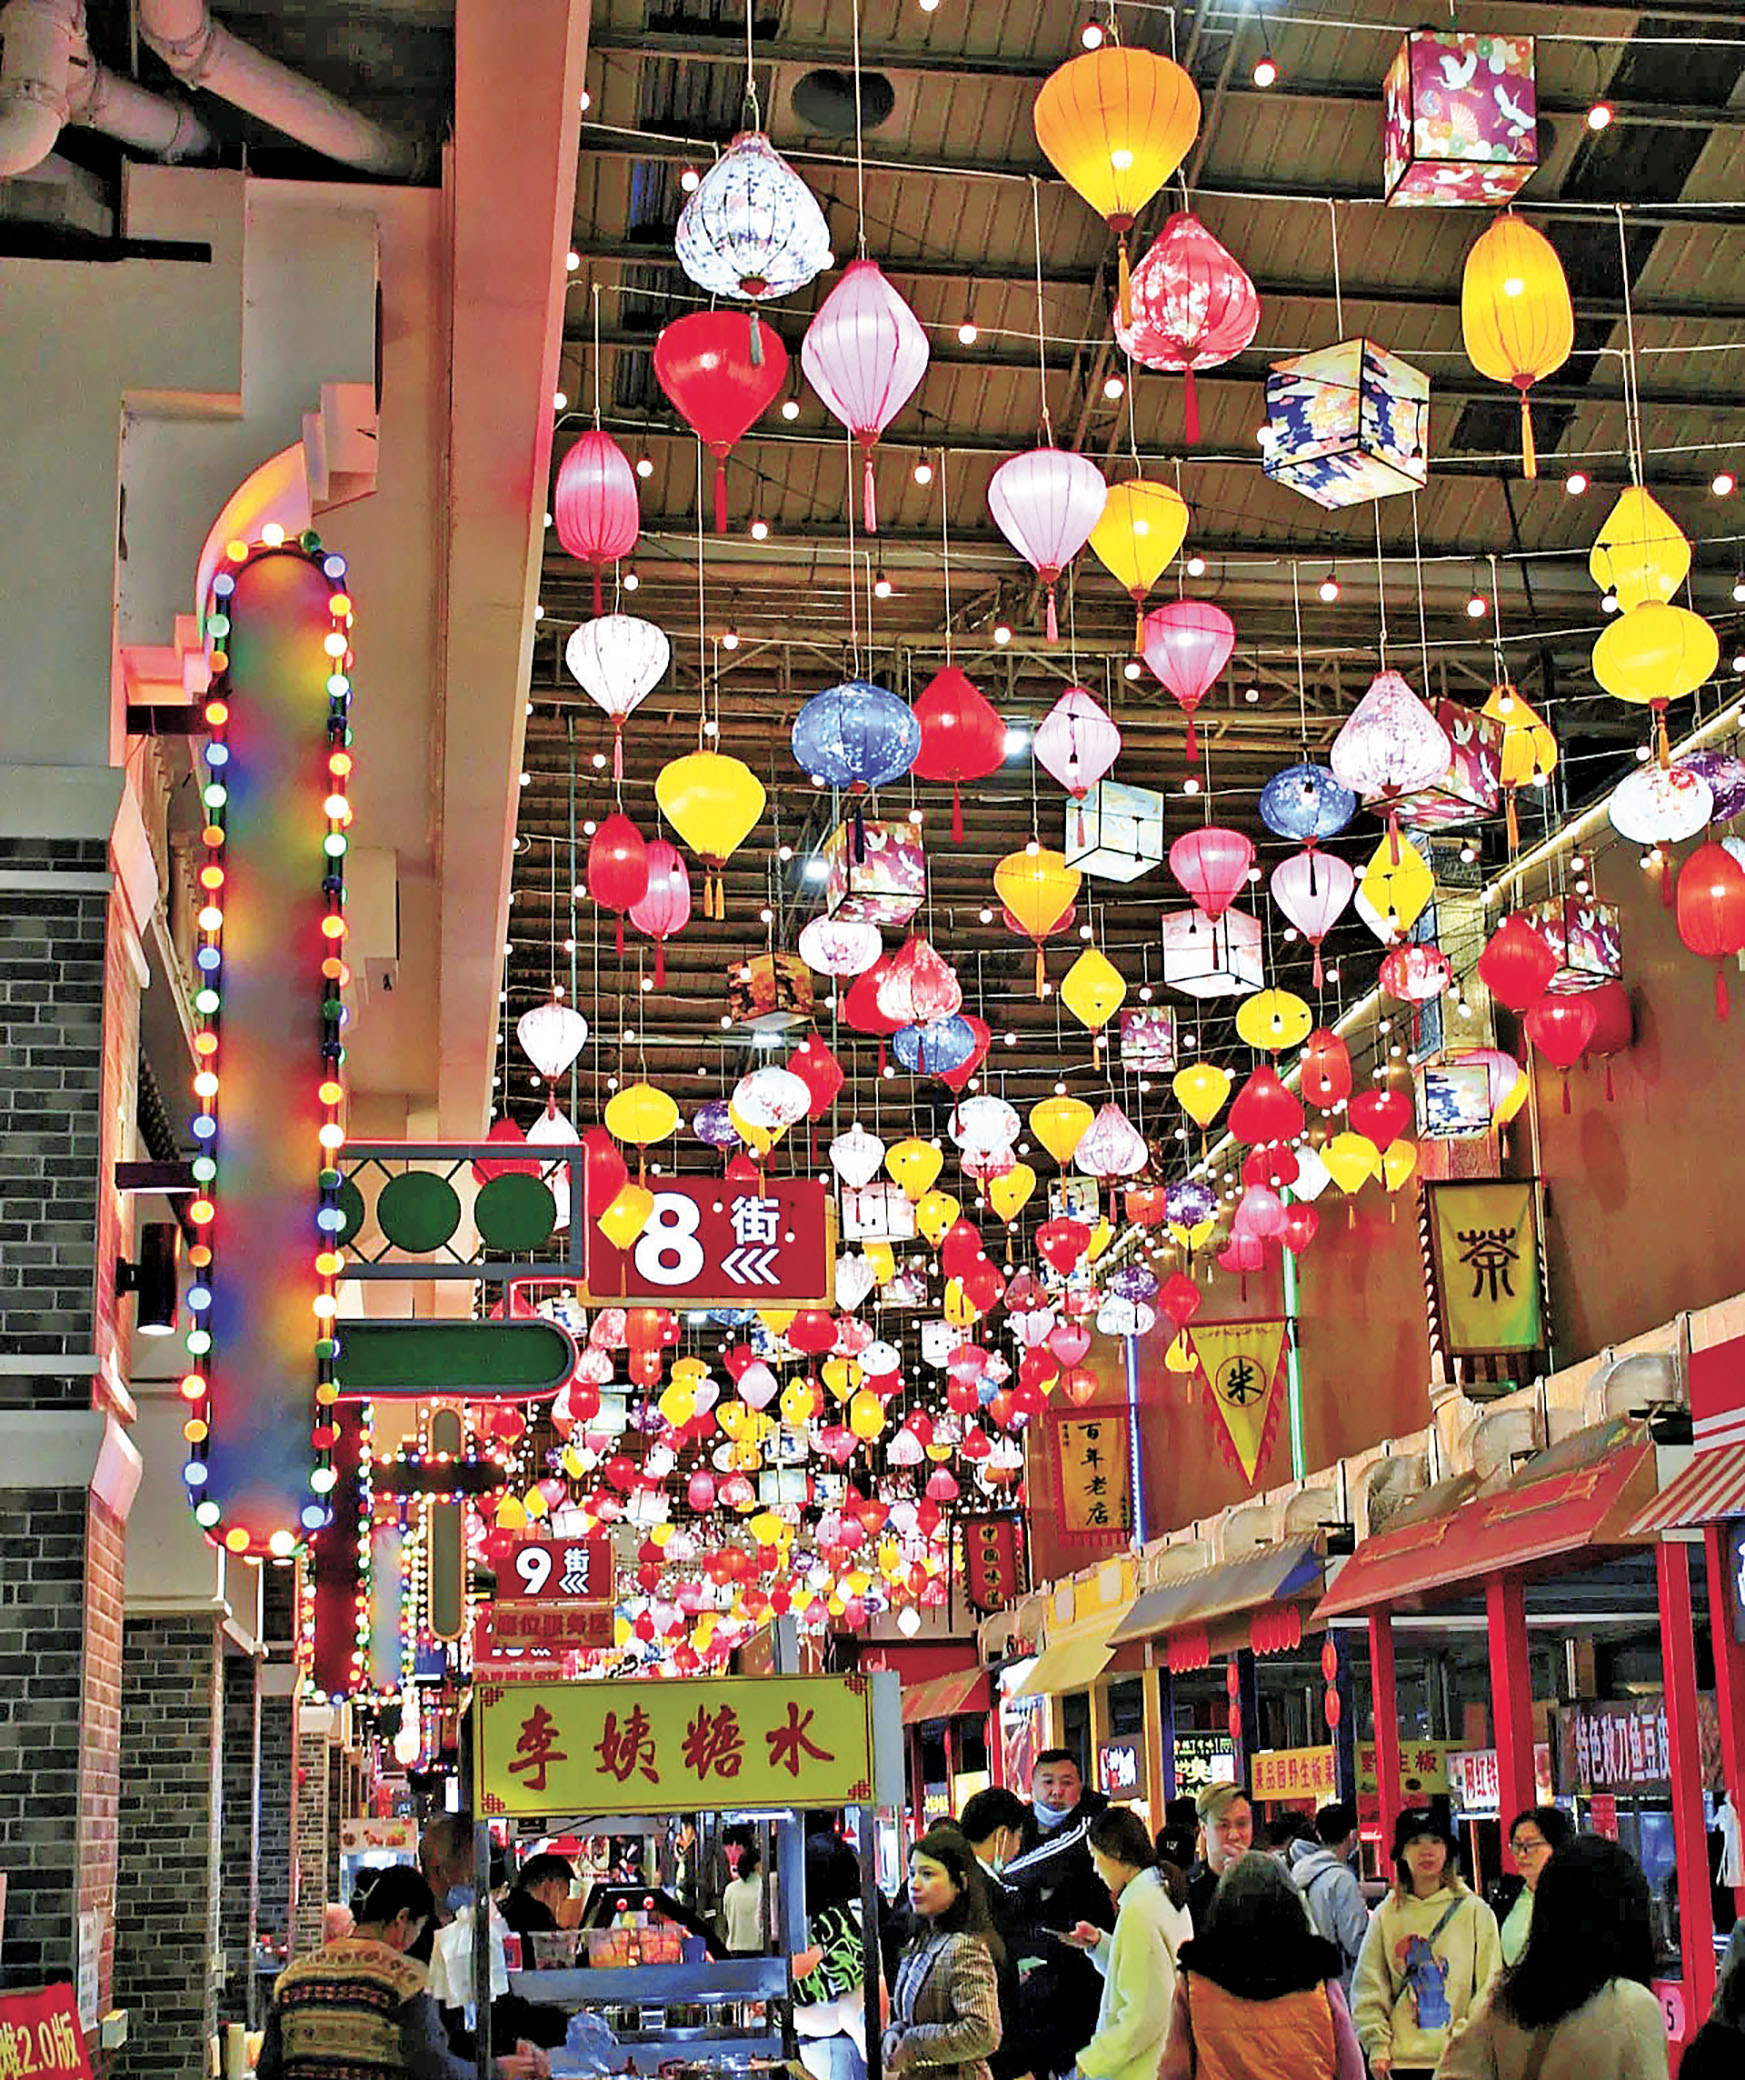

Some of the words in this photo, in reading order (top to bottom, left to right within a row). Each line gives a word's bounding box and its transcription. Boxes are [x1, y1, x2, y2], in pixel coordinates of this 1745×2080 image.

[1077, 1422, 1109, 1526] 百年老店
[508, 1701, 835, 1792] 李姨糖水
